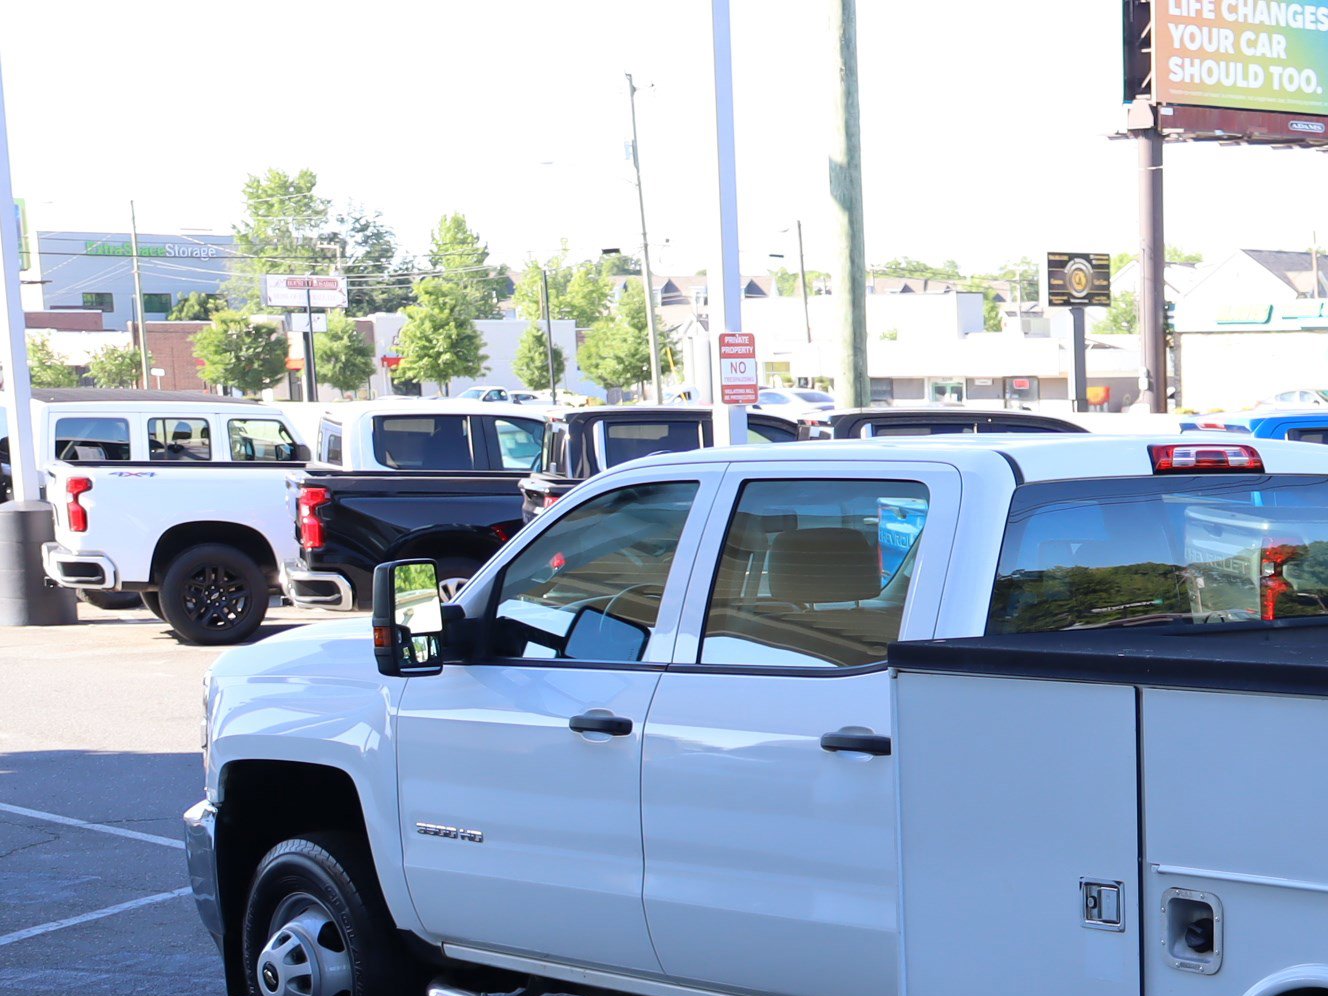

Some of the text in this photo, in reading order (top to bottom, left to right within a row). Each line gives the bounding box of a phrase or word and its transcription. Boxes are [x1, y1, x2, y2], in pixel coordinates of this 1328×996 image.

[1168, 0, 1216, 19] LIFE
[1168, 23, 1287, 59] YOUR CAR
[1168, 56, 1323, 94] SHOULD TOO.
[725, 336, 749, 344] PRIVATE
[721, 346, 753, 354] PROPERTY
[730, 361, 747, 374] NO
[416, 822, 483, 843] 3500 HD
